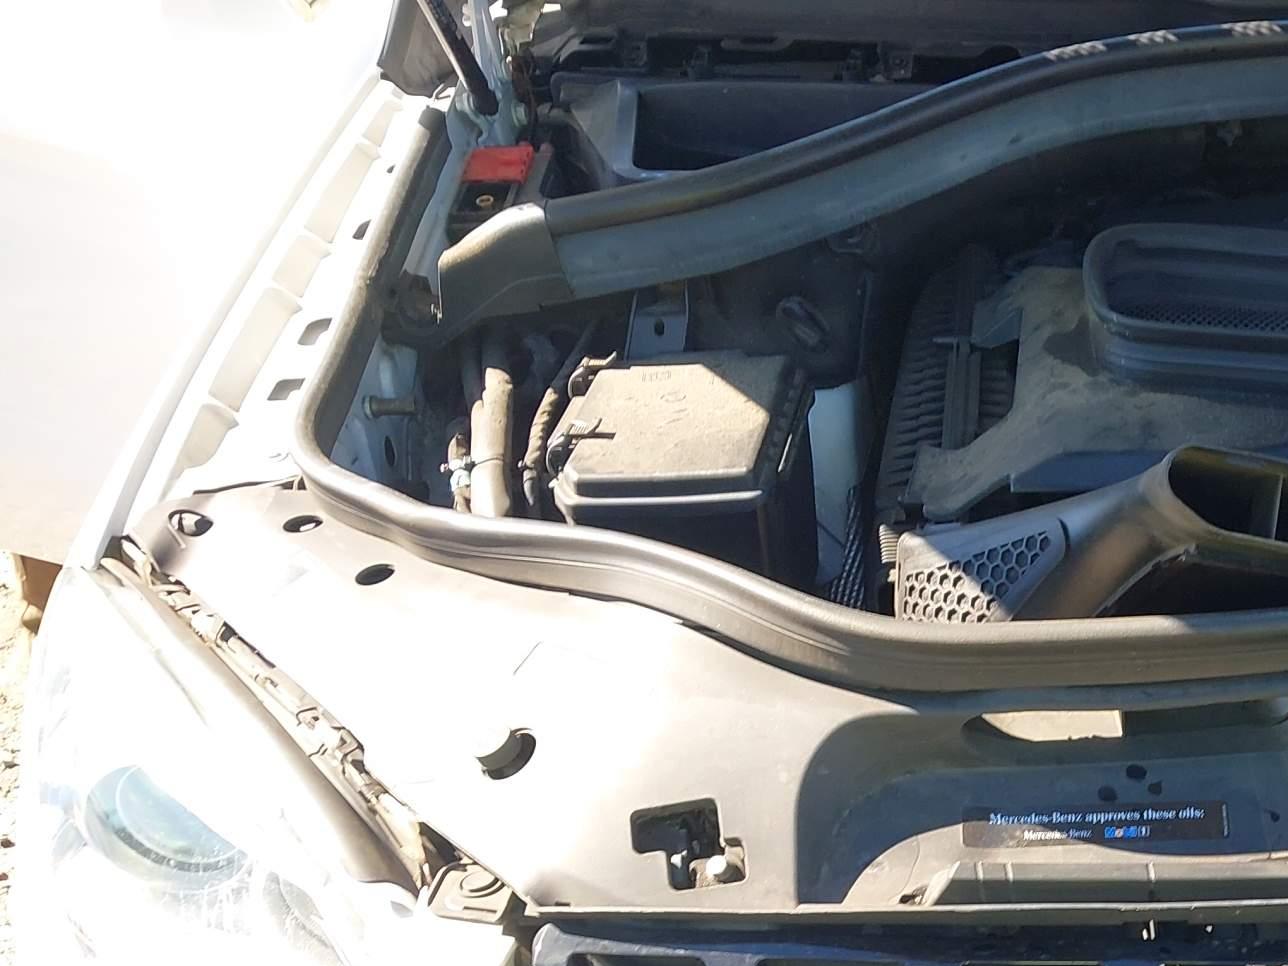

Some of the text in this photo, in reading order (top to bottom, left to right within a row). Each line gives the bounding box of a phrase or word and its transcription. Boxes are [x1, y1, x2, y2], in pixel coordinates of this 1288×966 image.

[989, 811, 1083, 826] Mercedes-Benz
[1085, 809, 1140, 824] approves
[1143, 808, 1176, 821] these
